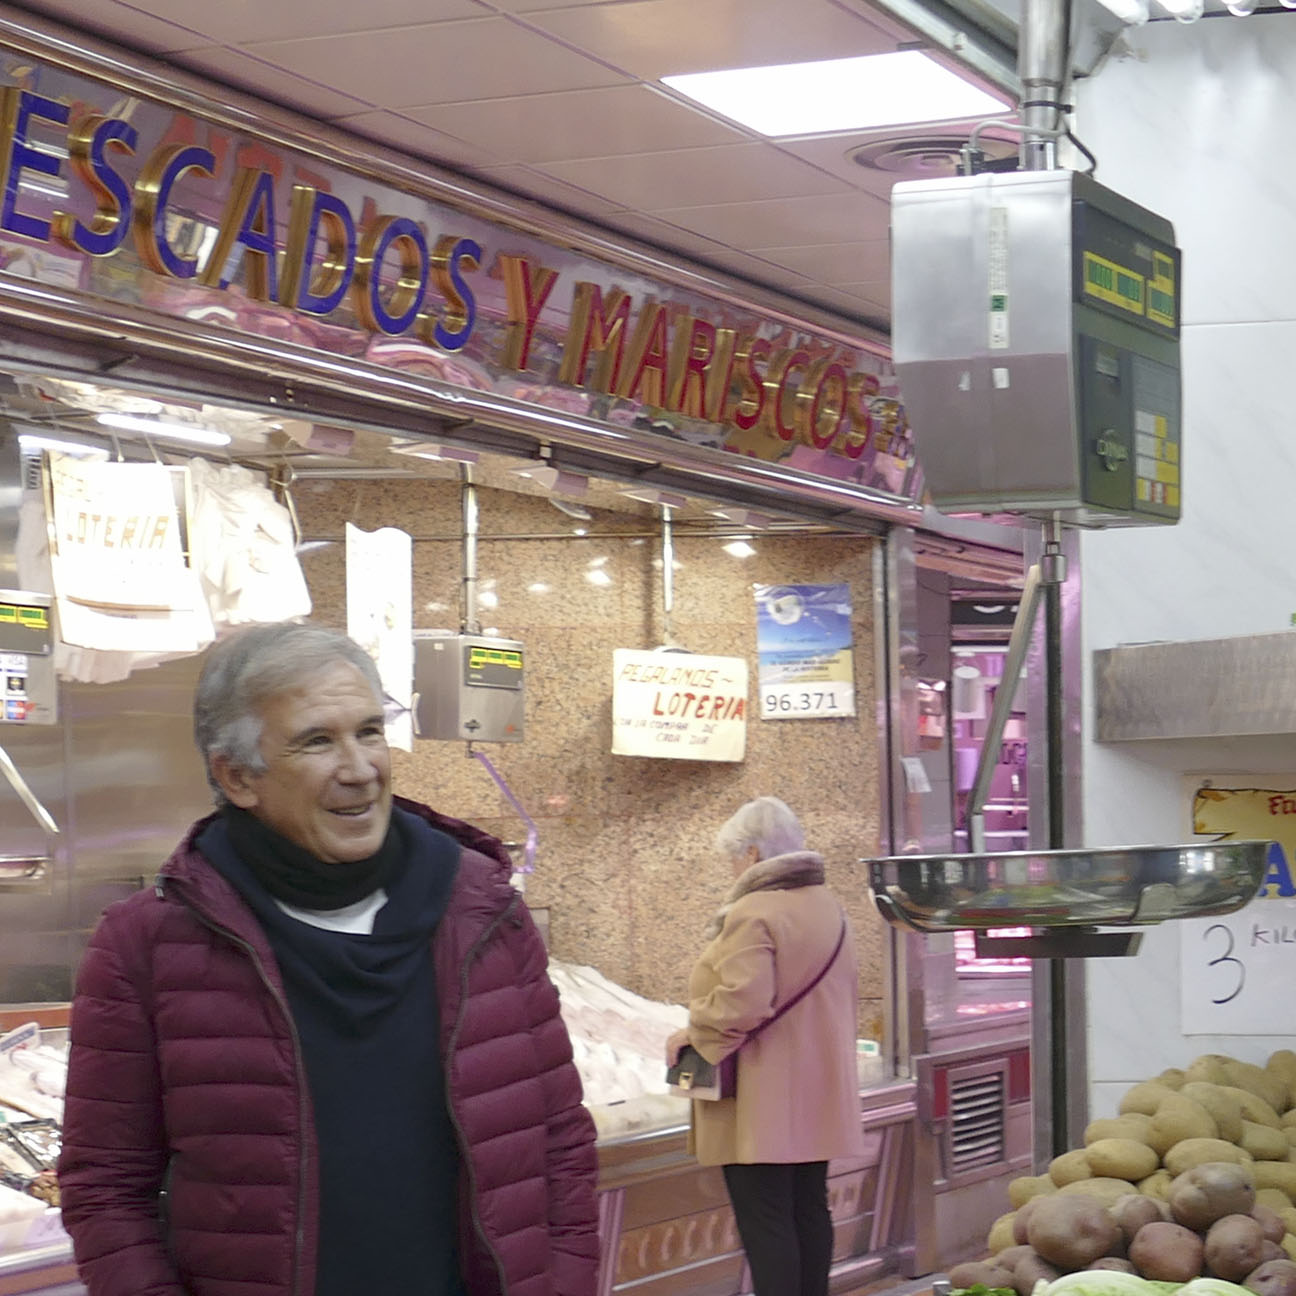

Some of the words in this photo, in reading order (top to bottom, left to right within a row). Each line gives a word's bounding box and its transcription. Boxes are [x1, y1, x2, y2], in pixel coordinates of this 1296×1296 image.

[504, 256, 559, 373] Y
[558, 281, 881, 460] MARISCOS
[652, 691, 746, 721] LOTERIA
[765, 691, 839, 713] 96.371
[1203, 923, 1246, 1004] 3
